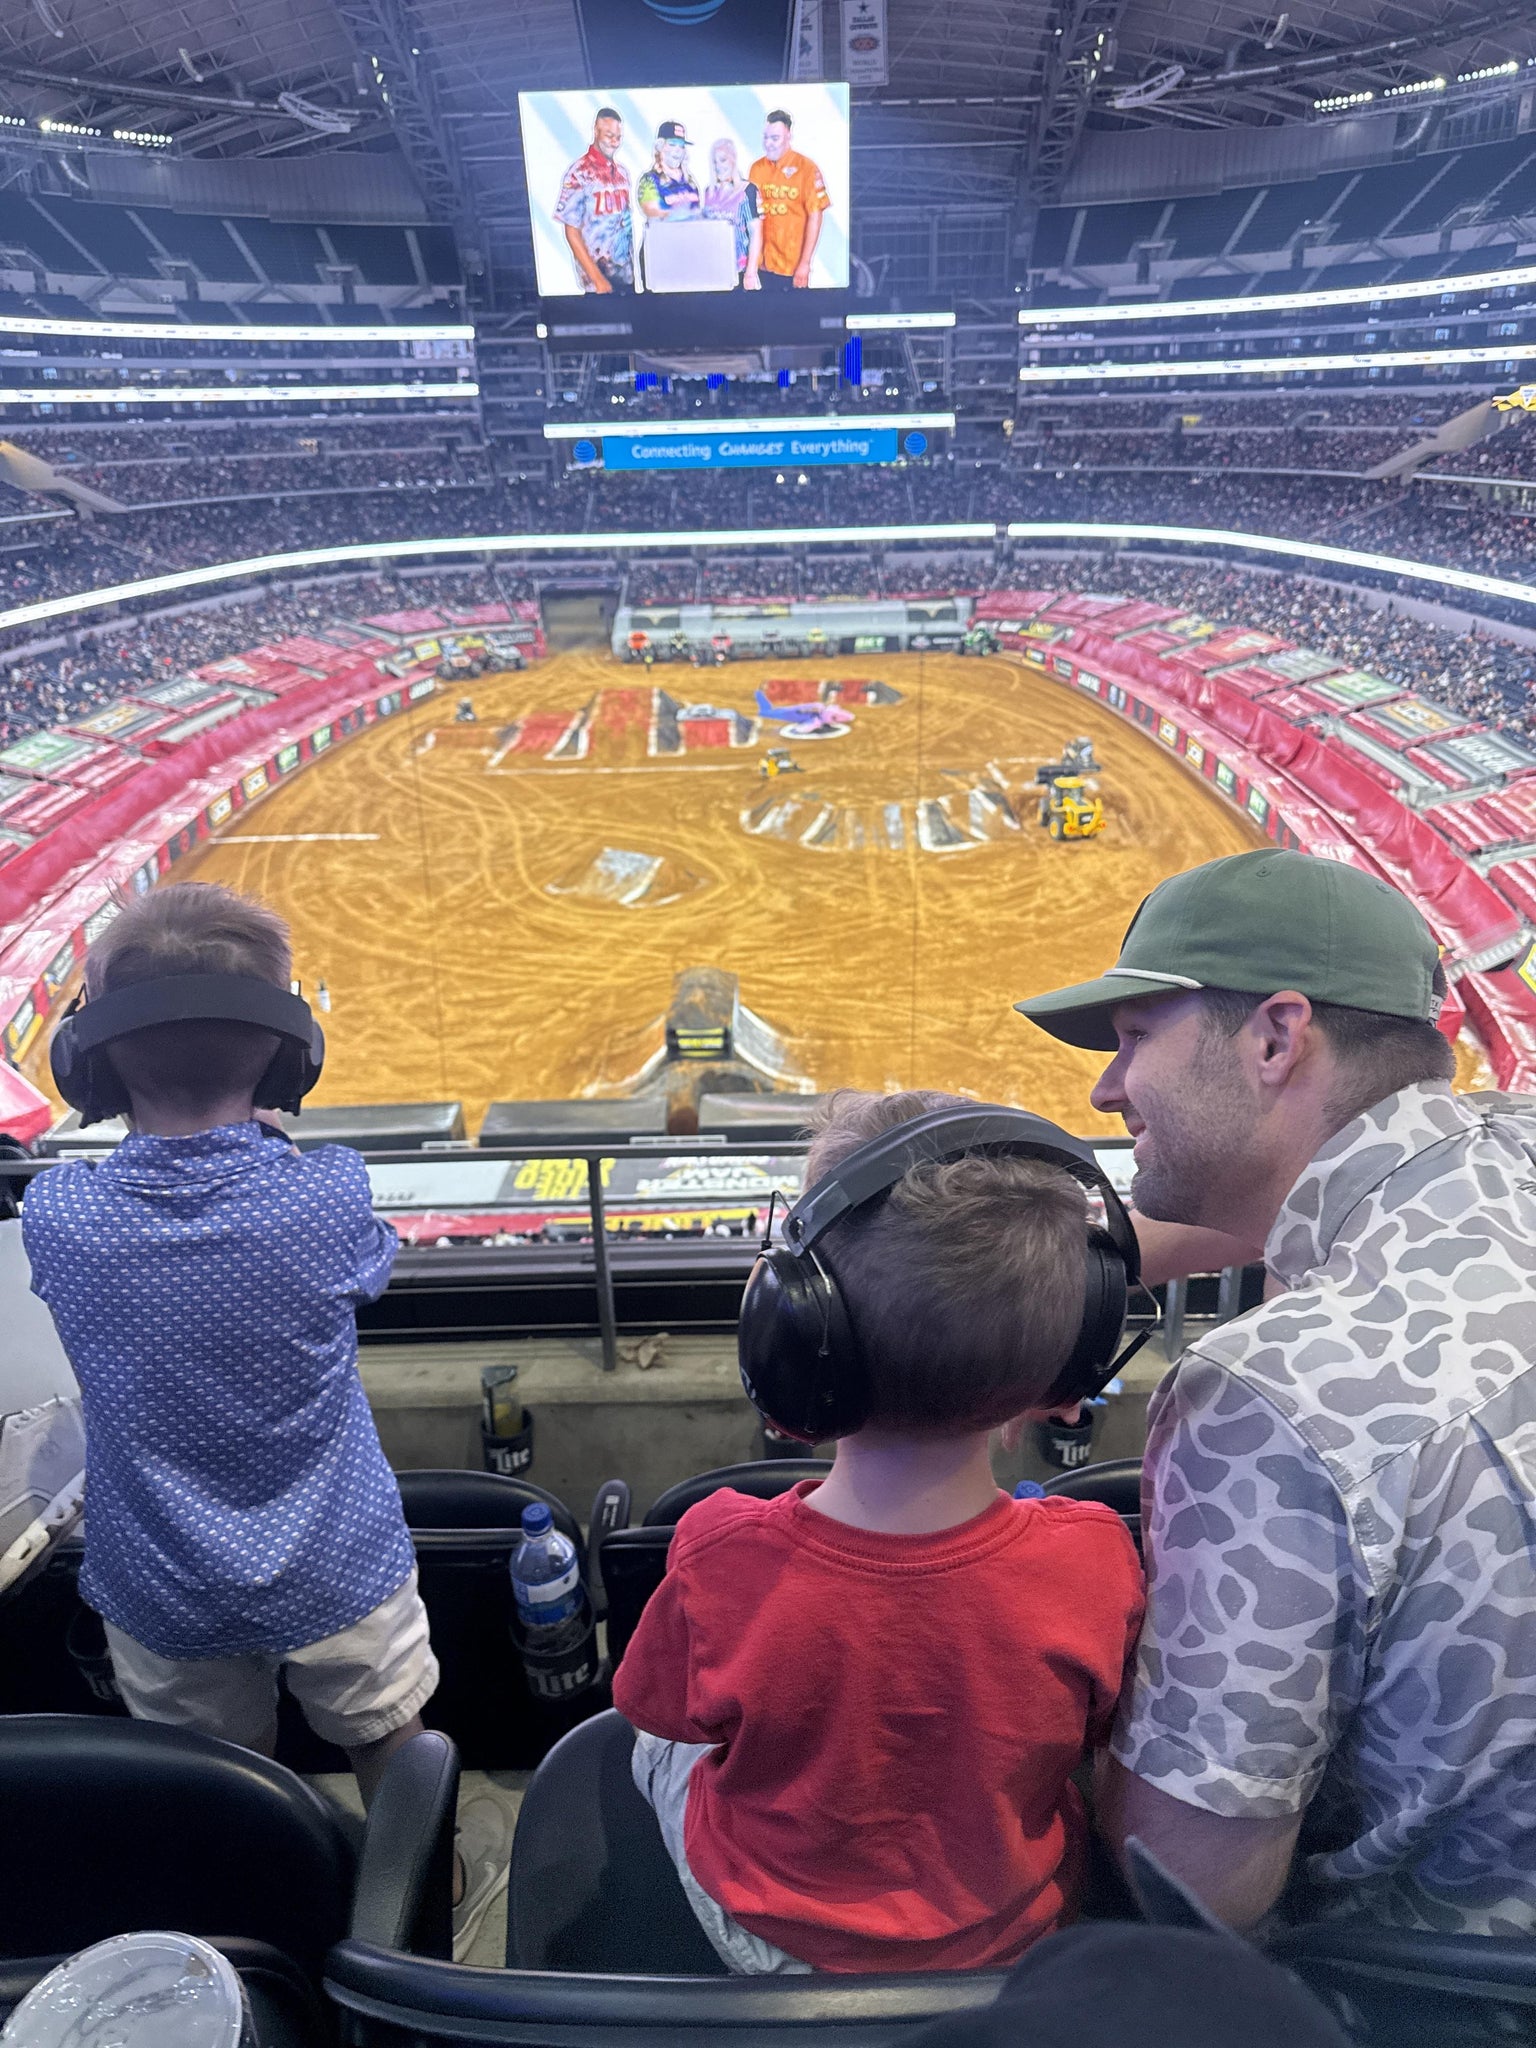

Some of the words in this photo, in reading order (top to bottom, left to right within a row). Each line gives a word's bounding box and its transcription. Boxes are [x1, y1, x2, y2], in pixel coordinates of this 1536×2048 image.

[631, 443, 712, 461] Connecting
[791, 438, 870, 458] Everything
[489, 1446, 530, 1471] Lite
[526, 1661, 590, 1696] Lite
